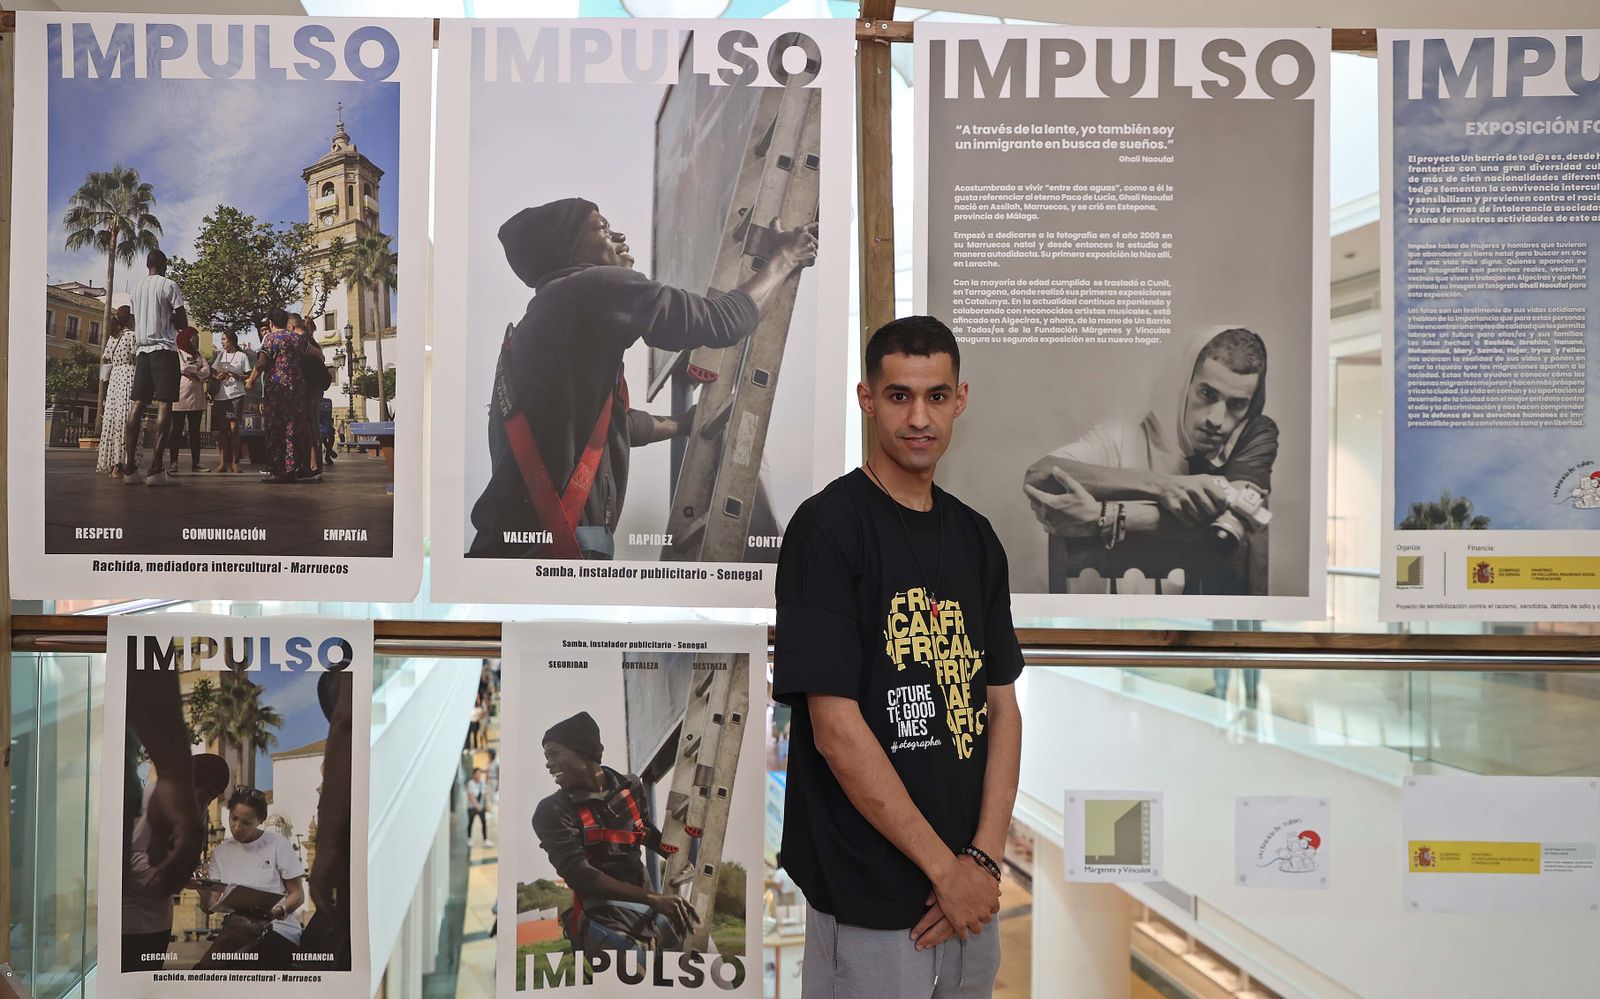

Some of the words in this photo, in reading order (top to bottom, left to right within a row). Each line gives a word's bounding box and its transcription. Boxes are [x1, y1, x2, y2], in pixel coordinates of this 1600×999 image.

[47, 23, 400, 81] IMPULSO
[471, 27, 822, 87] IMPULSO
[929, 38, 1315, 99] IMPULSO
[956, 125, 970, 134] “A
[972, 123, 1012, 134] través
[1014, 124, 1029, 133] de
[1031, 124, 1042, 133] la
[1044, 124, 1079, 135] lente,
[1081, 126, 1096, 137] yo
[1097, 123, 1150, 134] también
[1152, 126, 1174, 137] soy
[1465, 116, 1578, 135] EXPOSICIÓN
[955, 141, 971, 149] un
[973, 138, 1043, 151] inmigrante
[1062, 138, 1100, 148] busca
[1102, 138, 1117, 148] de
[1119, 139, 1173, 149] sueños.”
[1089, 184, 1121, 193] aguas”,
[954, 194, 977, 202] gusta
[1094, 193, 1117, 201] Lucía,
[954, 202, 977, 210] nació
[990, 202, 1022, 210] Assilah,
[1117, 203, 1157, 212] Estepona,
[954, 212, 992, 221] provincia
[1006, 212, 1039, 221] Málaga.
[954, 231, 985, 240] Empezó
[1056, 231, 1097, 240] fotografía
[966, 325, 1004, 334] Todas/os
[1034, 325, 1077, 333] Fundación
[1081, 326, 1121, 335] Márgenes
[75, 527, 122, 539] RESPETO
[182, 527, 265, 540] COMUNICACIÓN
[503, 530, 553, 543] VALENTÍA
[633, 534, 672, 545] RAPIDEZ
[93, 560, 142, 572] Rachida,
[146, 561, 208, 571] mediadora
[212, 561, 281, 572] intercultural
[291, 562, 348, 573] Marruecos
[535, 565, 575, 578] Samba,
[579, 566, 637, 578] instalador
[640, 567, 706, 579] publicitario
[717, 568, 762, 581] Senegal
[590, 640, 627, 648] instalador
[677, 641, 706, 649] Senegal
[127, 635, 353, 672] IMPULSO
[548, 660, 588, 669] SEGURIDAD
[622, 661, 659, 670] FORTALEZA
[693, 662, 728, 671] DESTREZA
[903, 701, 936, 720] GOOD
[1084, 866, 1117, 874] Márgenes
[141, 952, 177, 961] CERCANÍA
[211, 952, 258, 960] CORDIALIDAD
[516, 950, 745, 991] IMPULSO
[153, 973, 185, 981] Rachida,
[187, 973, 227, 981] mediadora
[282, 974, 321, 982] Marruecos
